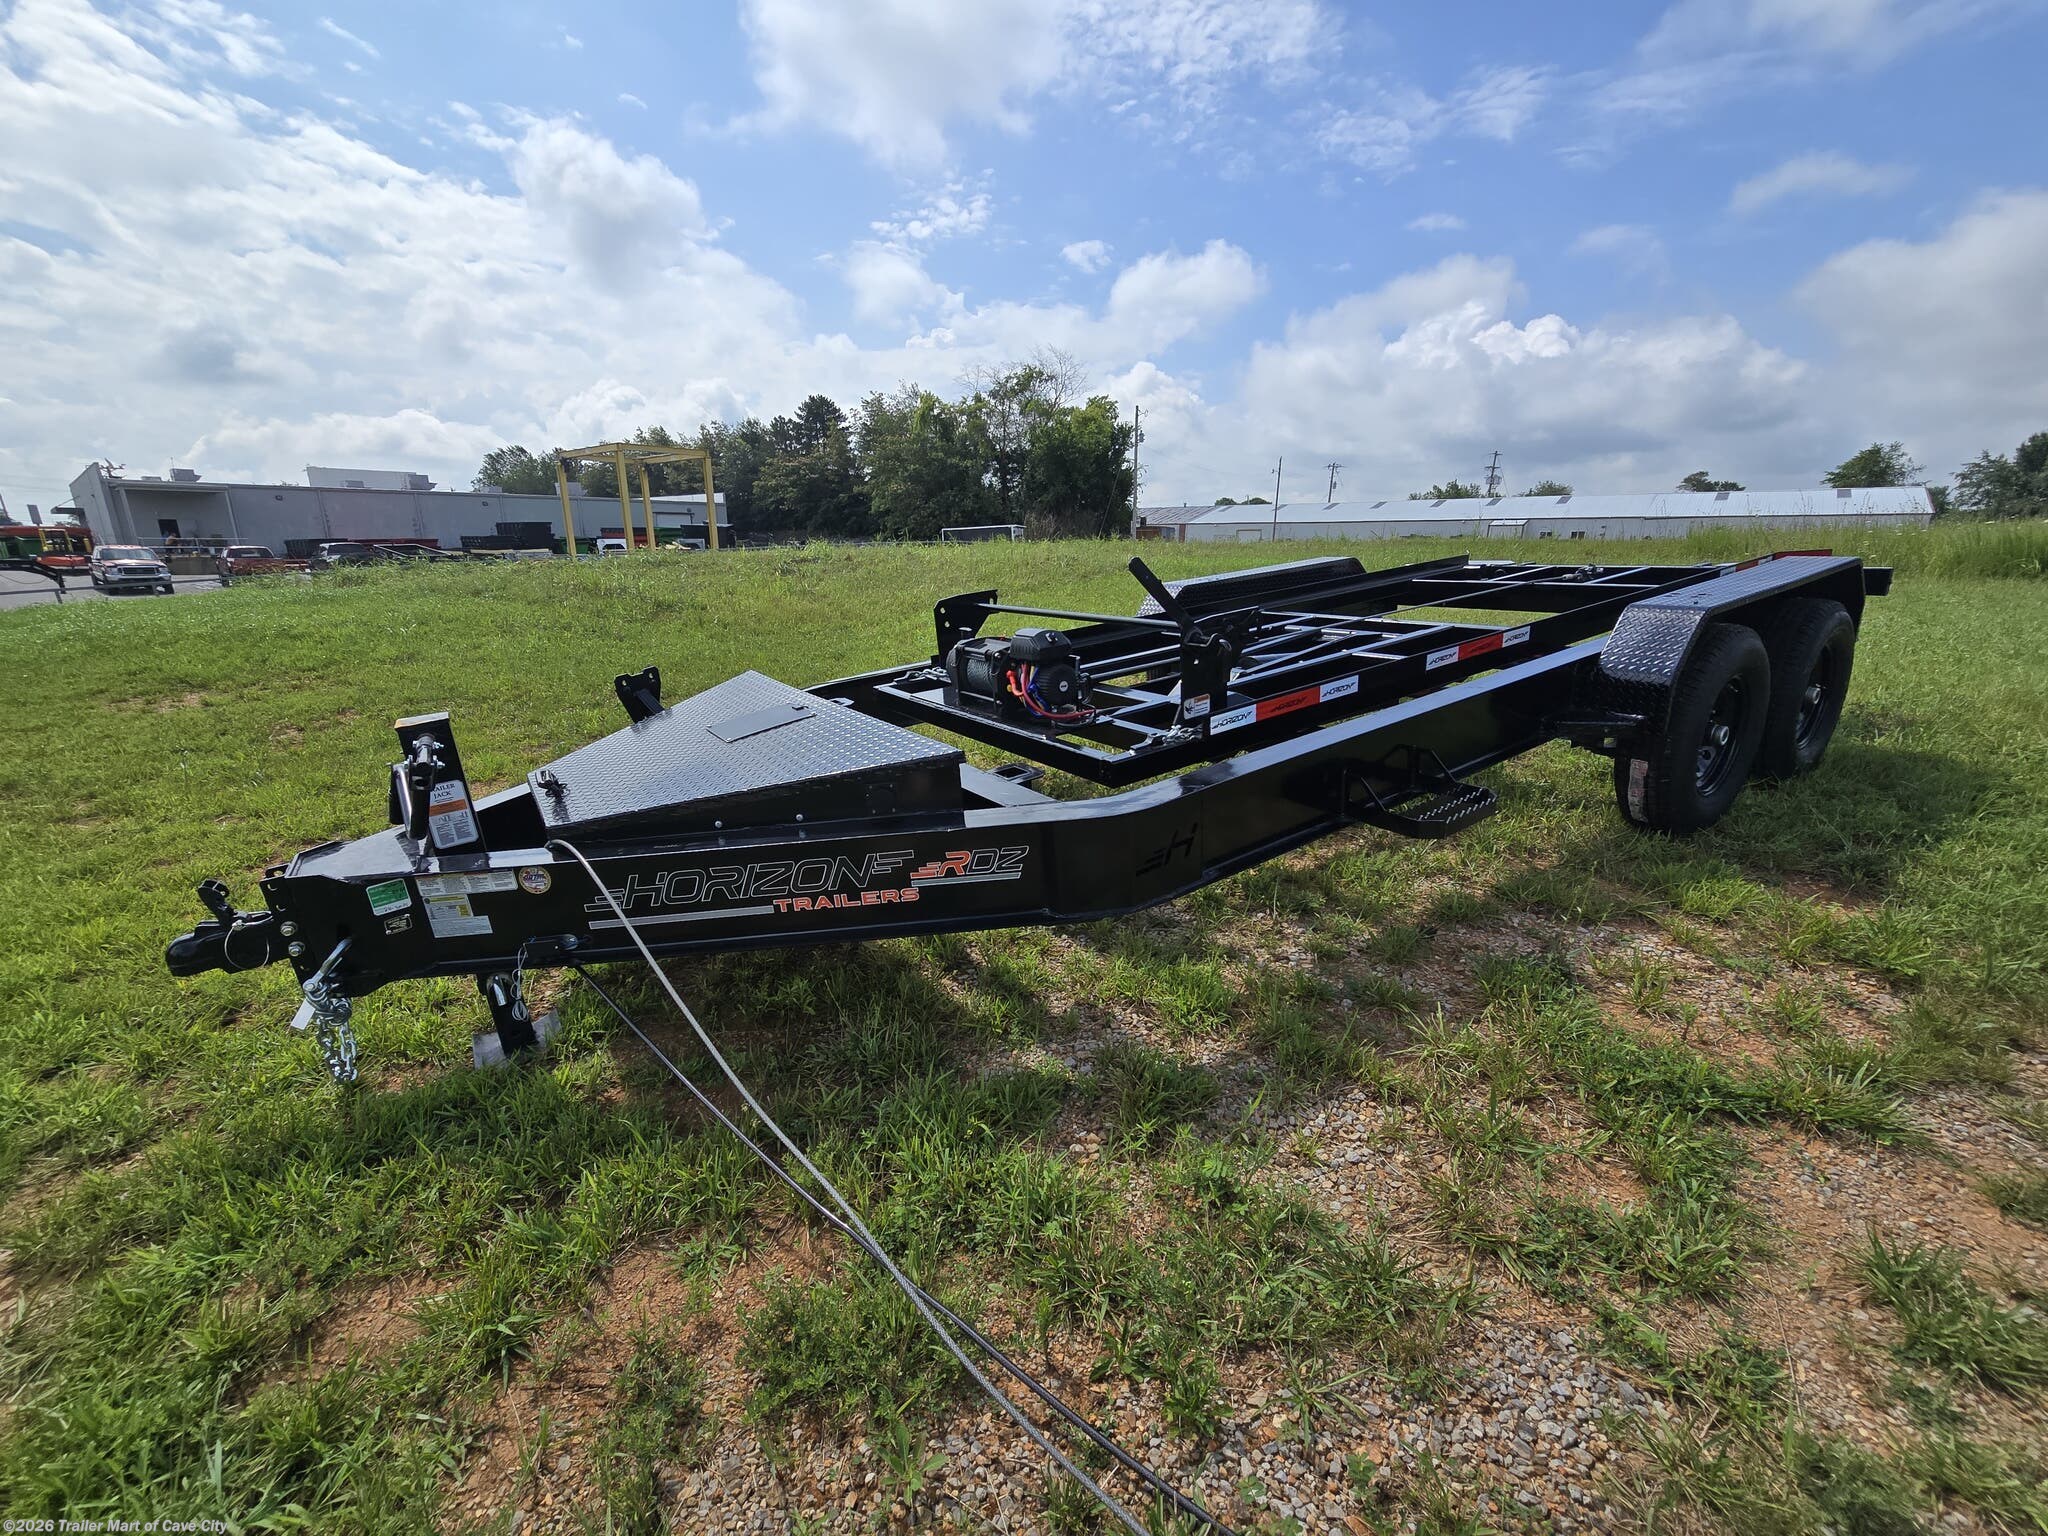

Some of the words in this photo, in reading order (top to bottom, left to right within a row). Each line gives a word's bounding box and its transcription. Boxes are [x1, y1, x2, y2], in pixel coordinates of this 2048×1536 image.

[1324, 684, 1353, 697] HORIZON
[1215, 713, 1249, 728] HORIZON
[939, 845, 1029, 875] RDZ
[622, 853, 876, 908] HORIZON
[773, 887, 919, 913] TRAILERS
